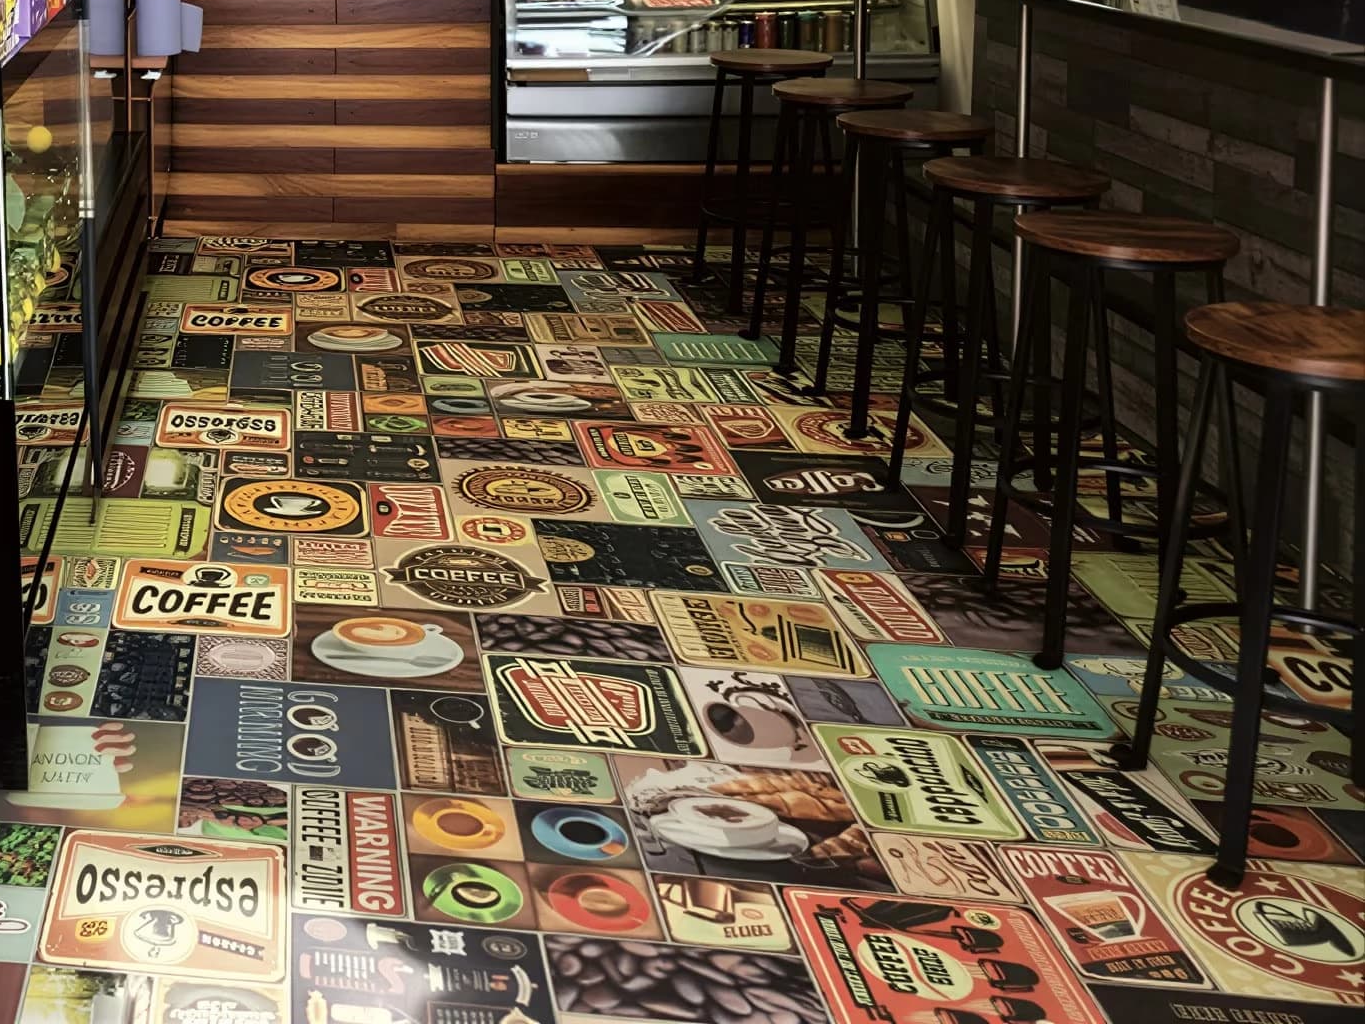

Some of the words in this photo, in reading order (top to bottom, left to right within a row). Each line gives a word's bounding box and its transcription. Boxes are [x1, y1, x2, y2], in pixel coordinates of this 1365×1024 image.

[131, 584, 277, 621] COFFEE
[353, 796, 396, 911] WARNING
[1011, 848, 1130, 887] COFFEE
[76, 862, 259, 918] espresso
